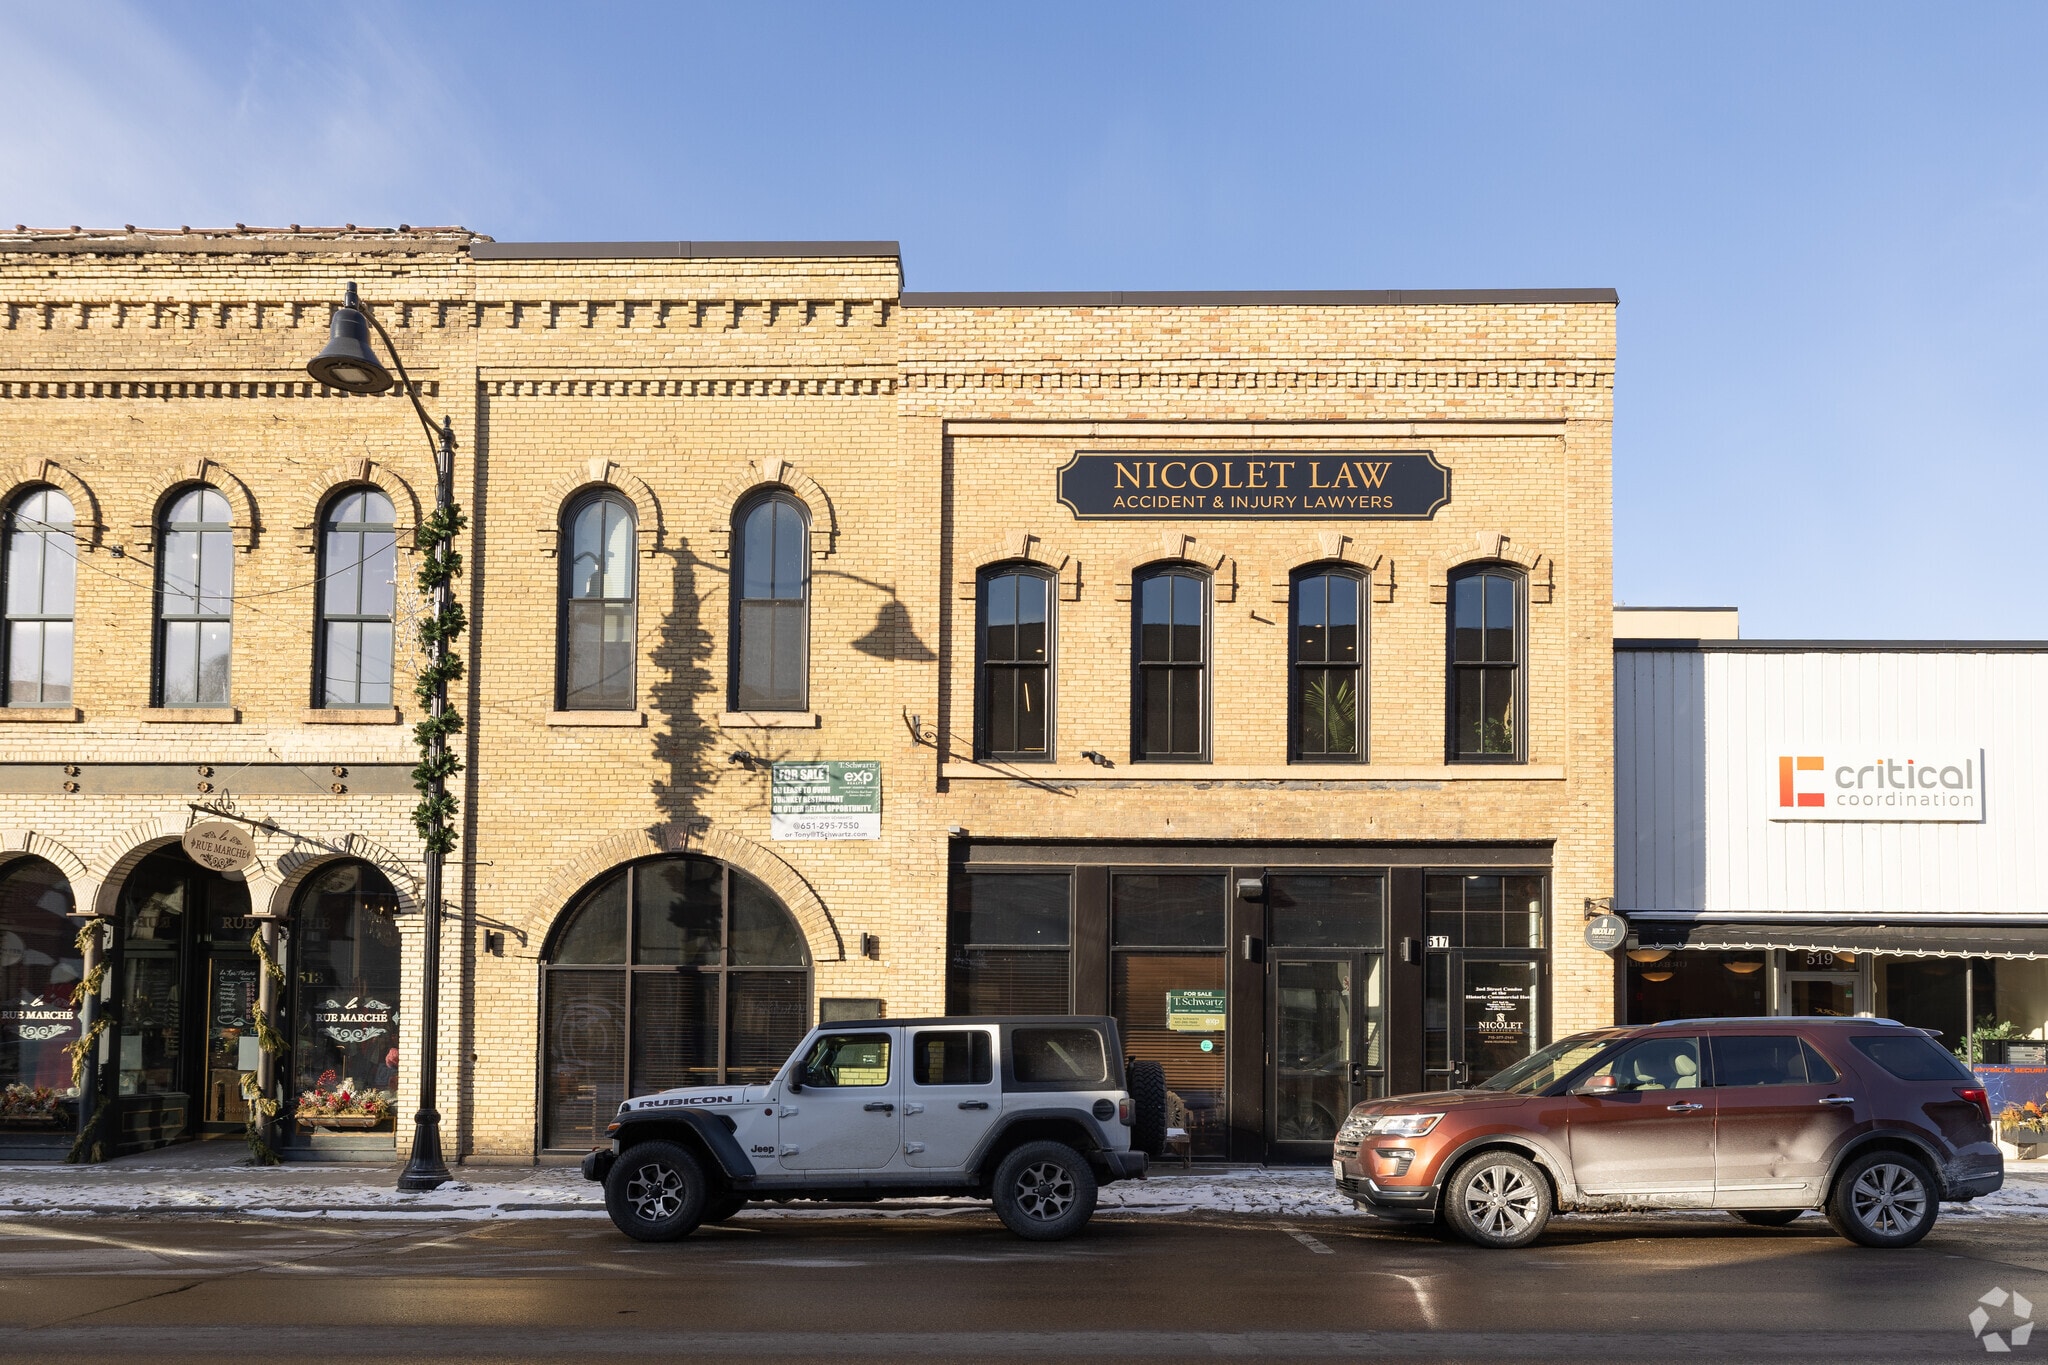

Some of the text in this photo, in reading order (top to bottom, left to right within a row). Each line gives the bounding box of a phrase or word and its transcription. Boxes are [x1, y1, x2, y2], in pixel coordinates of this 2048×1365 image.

[1113, 461, 1393, 489] NICOLET LAW
[1113, 495, 1393, 509] ACCIDENT & INJURY LAWYERS
[778, 768, 825, 780] FOR SALE
[844, 770, 873, 785] exp
[1835, 758, 1973, 789] critical
[773, 795, 844, 803] TURNKEY RESTAURANT
[1836, 791, 1974, 807] coordination
[773, 804, 783, 812] OR
[783, 804, 804, 812] OTHER
[804, 804, 826, 812] RETAIL
[195, 839, 248, 859] RUE MARCHÉ
[222, 916, 255, 929] RUE
[1427, 936, 1449, 947] 517
[1806, 952, 1833, 965] 519
[299, 971, 324, 984] 513
[1182, 997, 1223, 1006] Schwartz
[2, 1008, 74, 1020] RUE MARCHÉ
[315, 1010, 388, 1023] RUE MARCHÉ
[1478, 1021, 1523, 1029] NICOLET
[638, 1095, 733, 1108] RUBICON
[750, 1145, 775, 1154] Jeep
